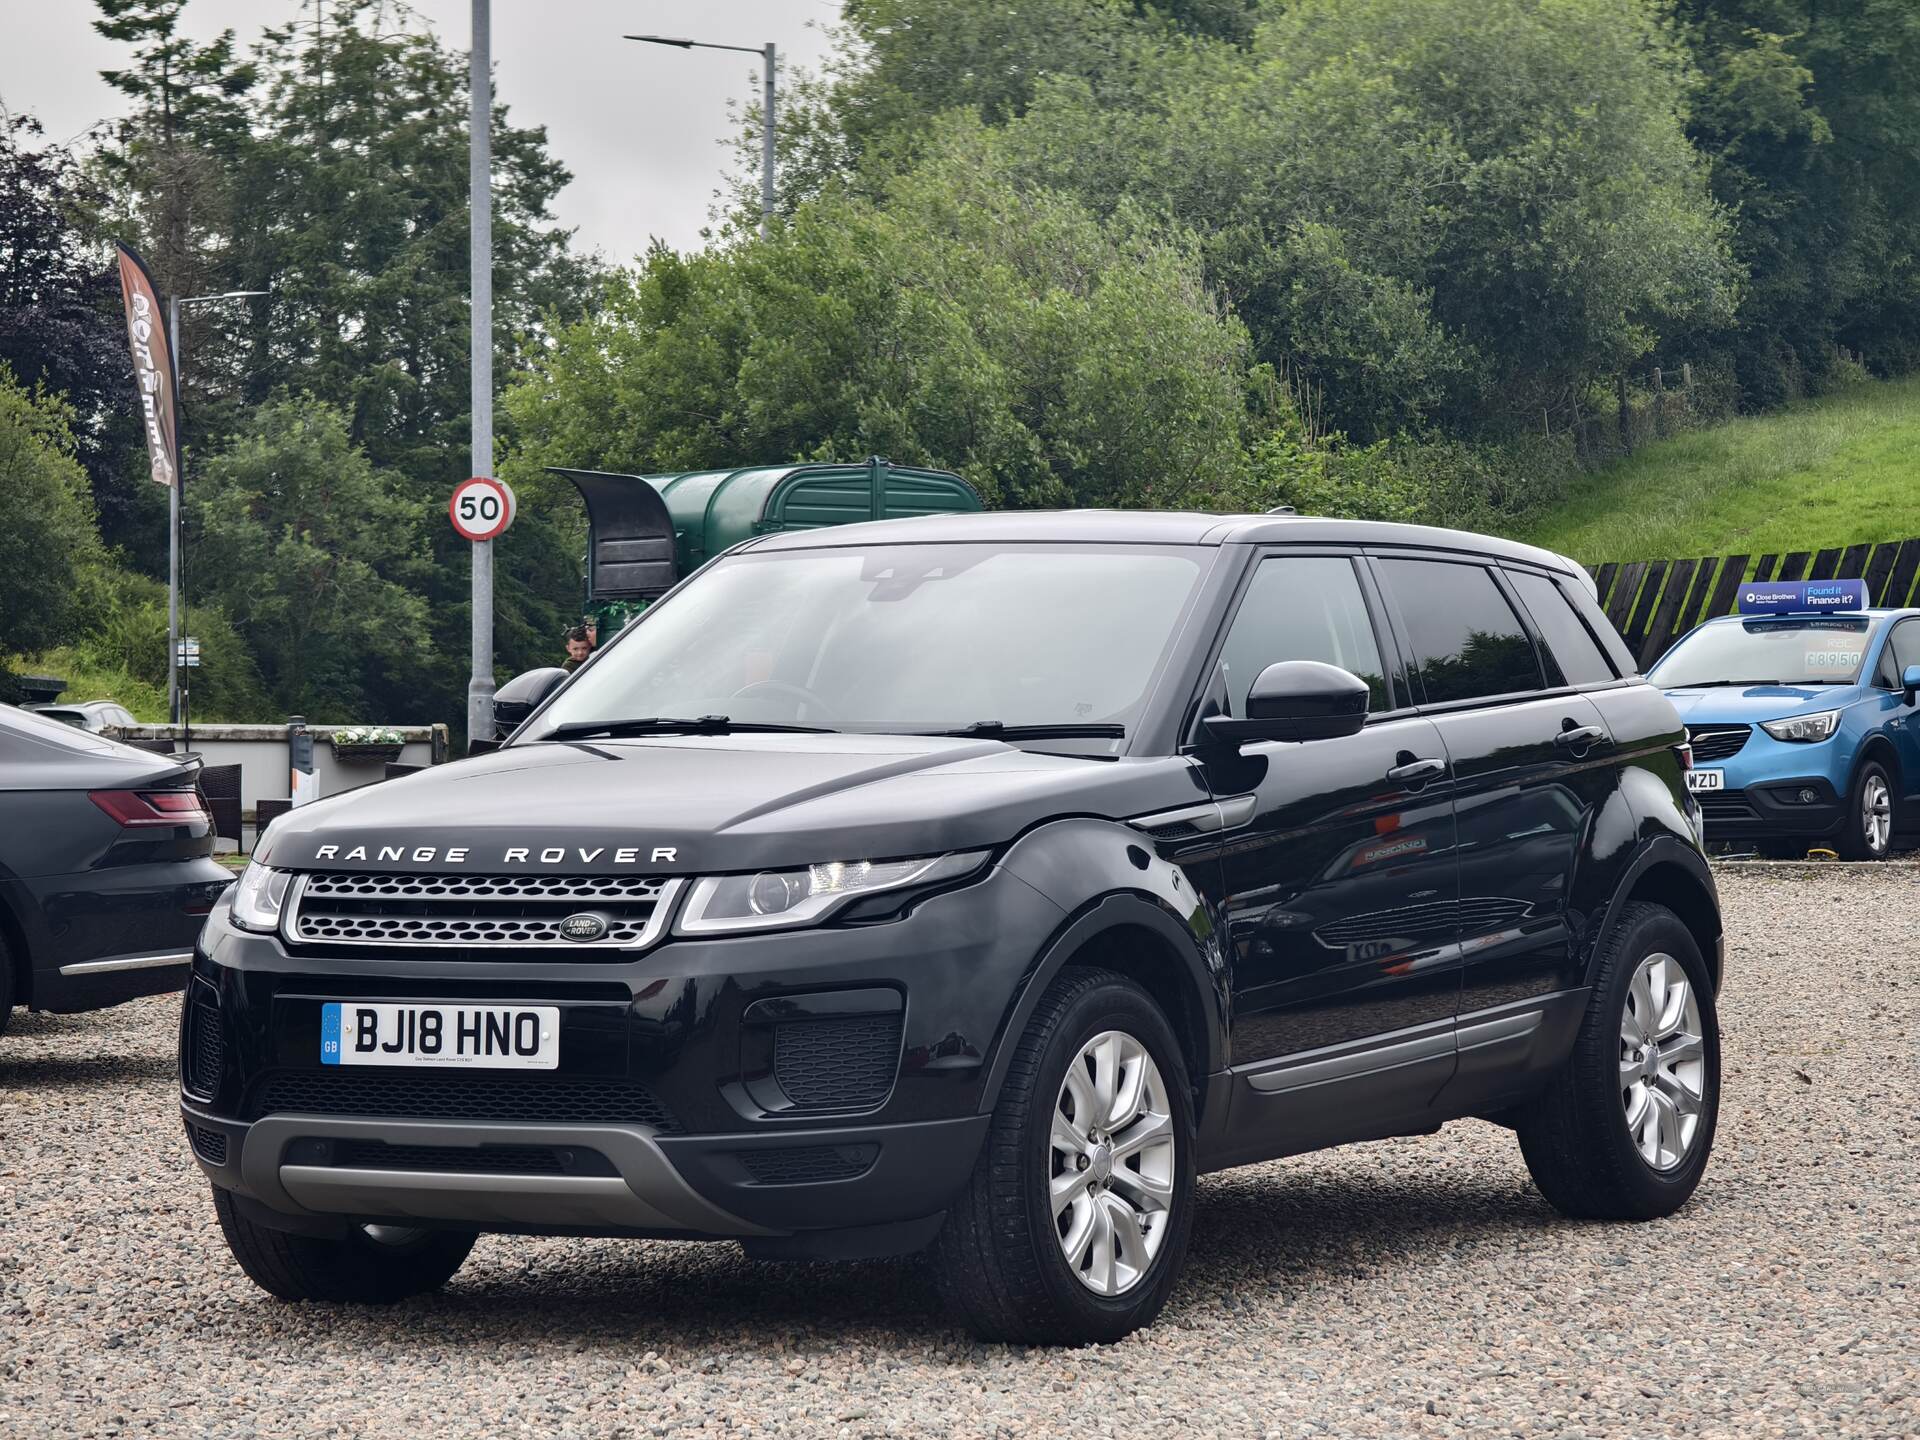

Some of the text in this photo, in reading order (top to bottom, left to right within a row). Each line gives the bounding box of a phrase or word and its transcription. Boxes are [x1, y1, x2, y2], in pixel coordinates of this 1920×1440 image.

[460, 496, 499, 520] 50
[1808, 587, 1834, 595] Found
[1808, 595, 1853, 604] Finance it?
[1808, 654, 1859, 666] £8950
[1688, 773, 1717, 788] WZD
[315, 845, 678, 864] RANGE ROVER
[569, 919, 590, 927] LAND
[570, 927, 597, 935] ROVER
[355, 1008, 540, 1056] BJ18 HNO
[324, 1041, 338, 1053] GB
